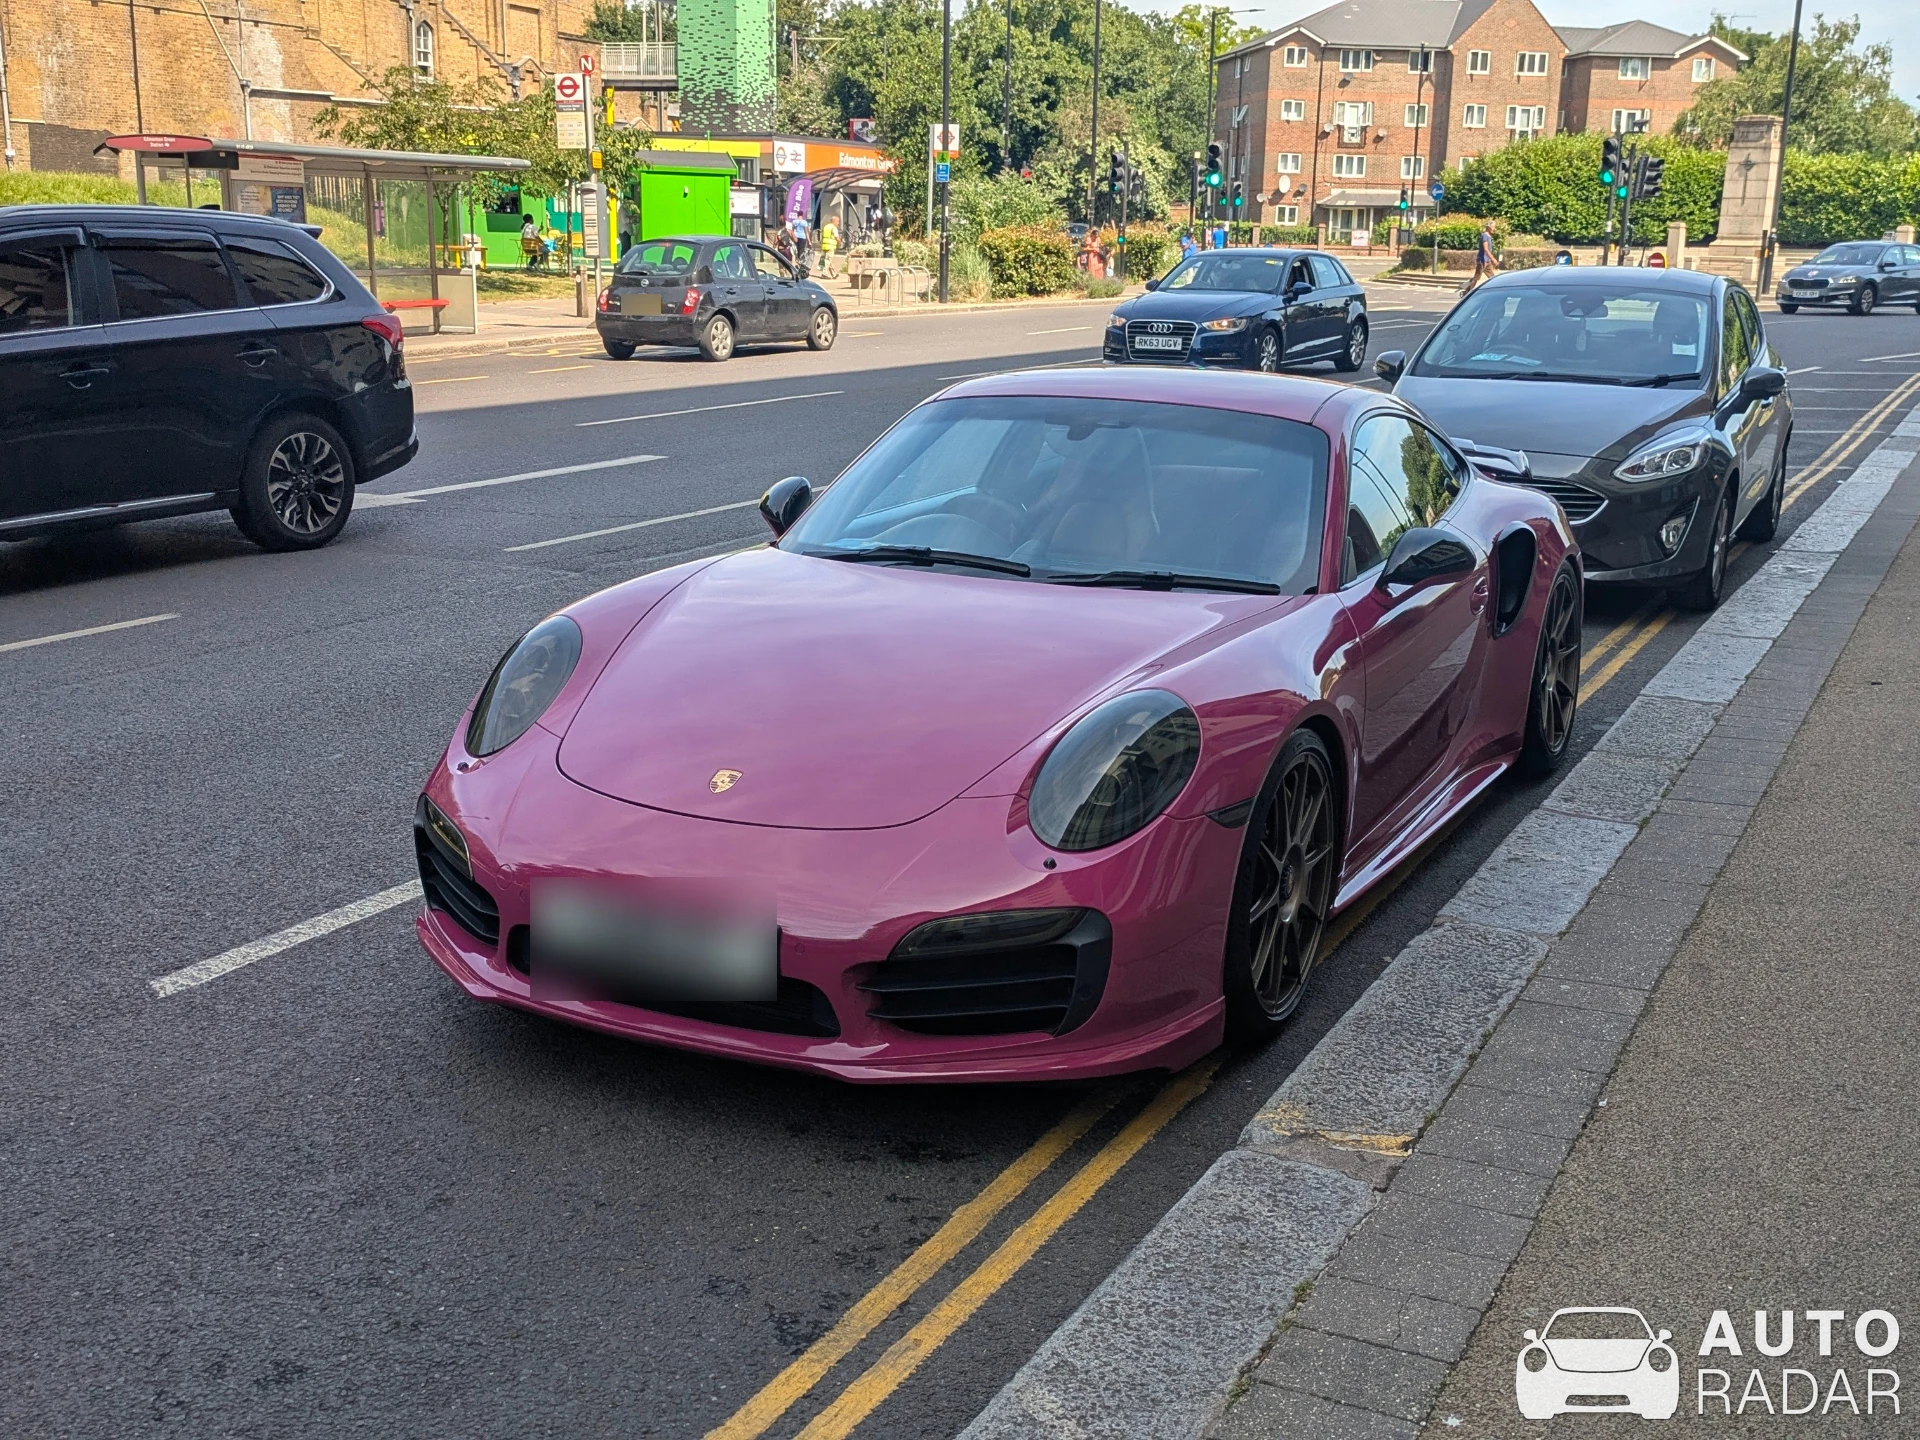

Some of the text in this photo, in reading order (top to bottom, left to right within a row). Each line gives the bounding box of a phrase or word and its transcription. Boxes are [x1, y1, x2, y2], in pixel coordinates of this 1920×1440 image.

[580, 57, 593, 71] N
[839, 151, 876, 169] Edmonton
[1138, 338, 1178, 348] RK63 UGV
